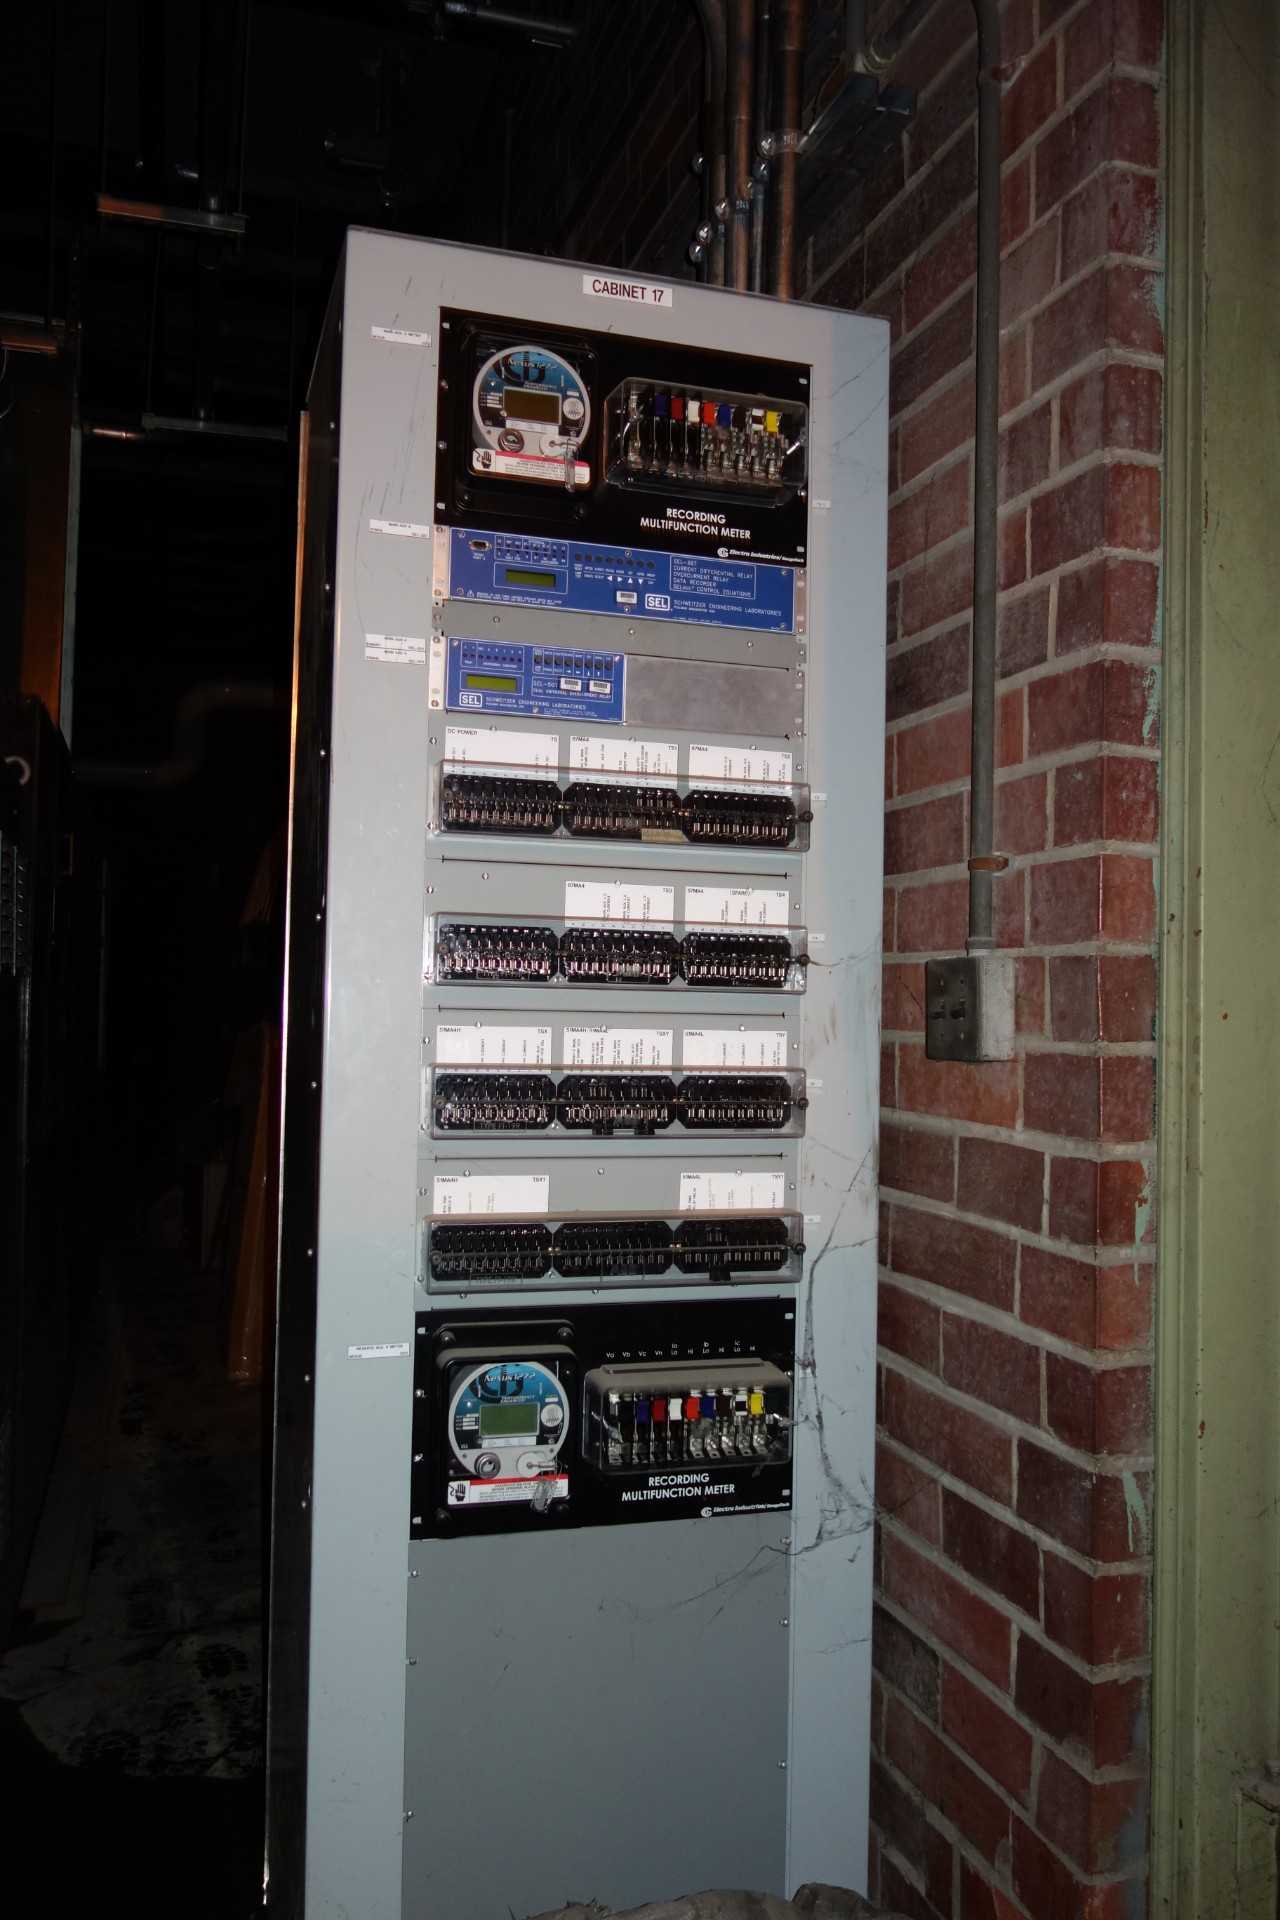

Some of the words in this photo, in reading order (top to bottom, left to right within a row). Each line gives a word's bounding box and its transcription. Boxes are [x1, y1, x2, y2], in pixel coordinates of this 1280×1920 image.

[592, 279, 647, 300] CABINET
[652, 288, 664, 303] 17
[666, 507, 727, 525] RECORDING
[640, 517, 719, 536] MULTIFUNCTION
[721, 528, 751, 540] METER
[647, 596, 668, 608] SEL
[462, 694, 480, 705] SEL
[648, 1473, 710, 1487] RECORDING
[621, 1486, 702, 1502] MULTIFUNCTION
[704, 1484, 735, 1496] METER
